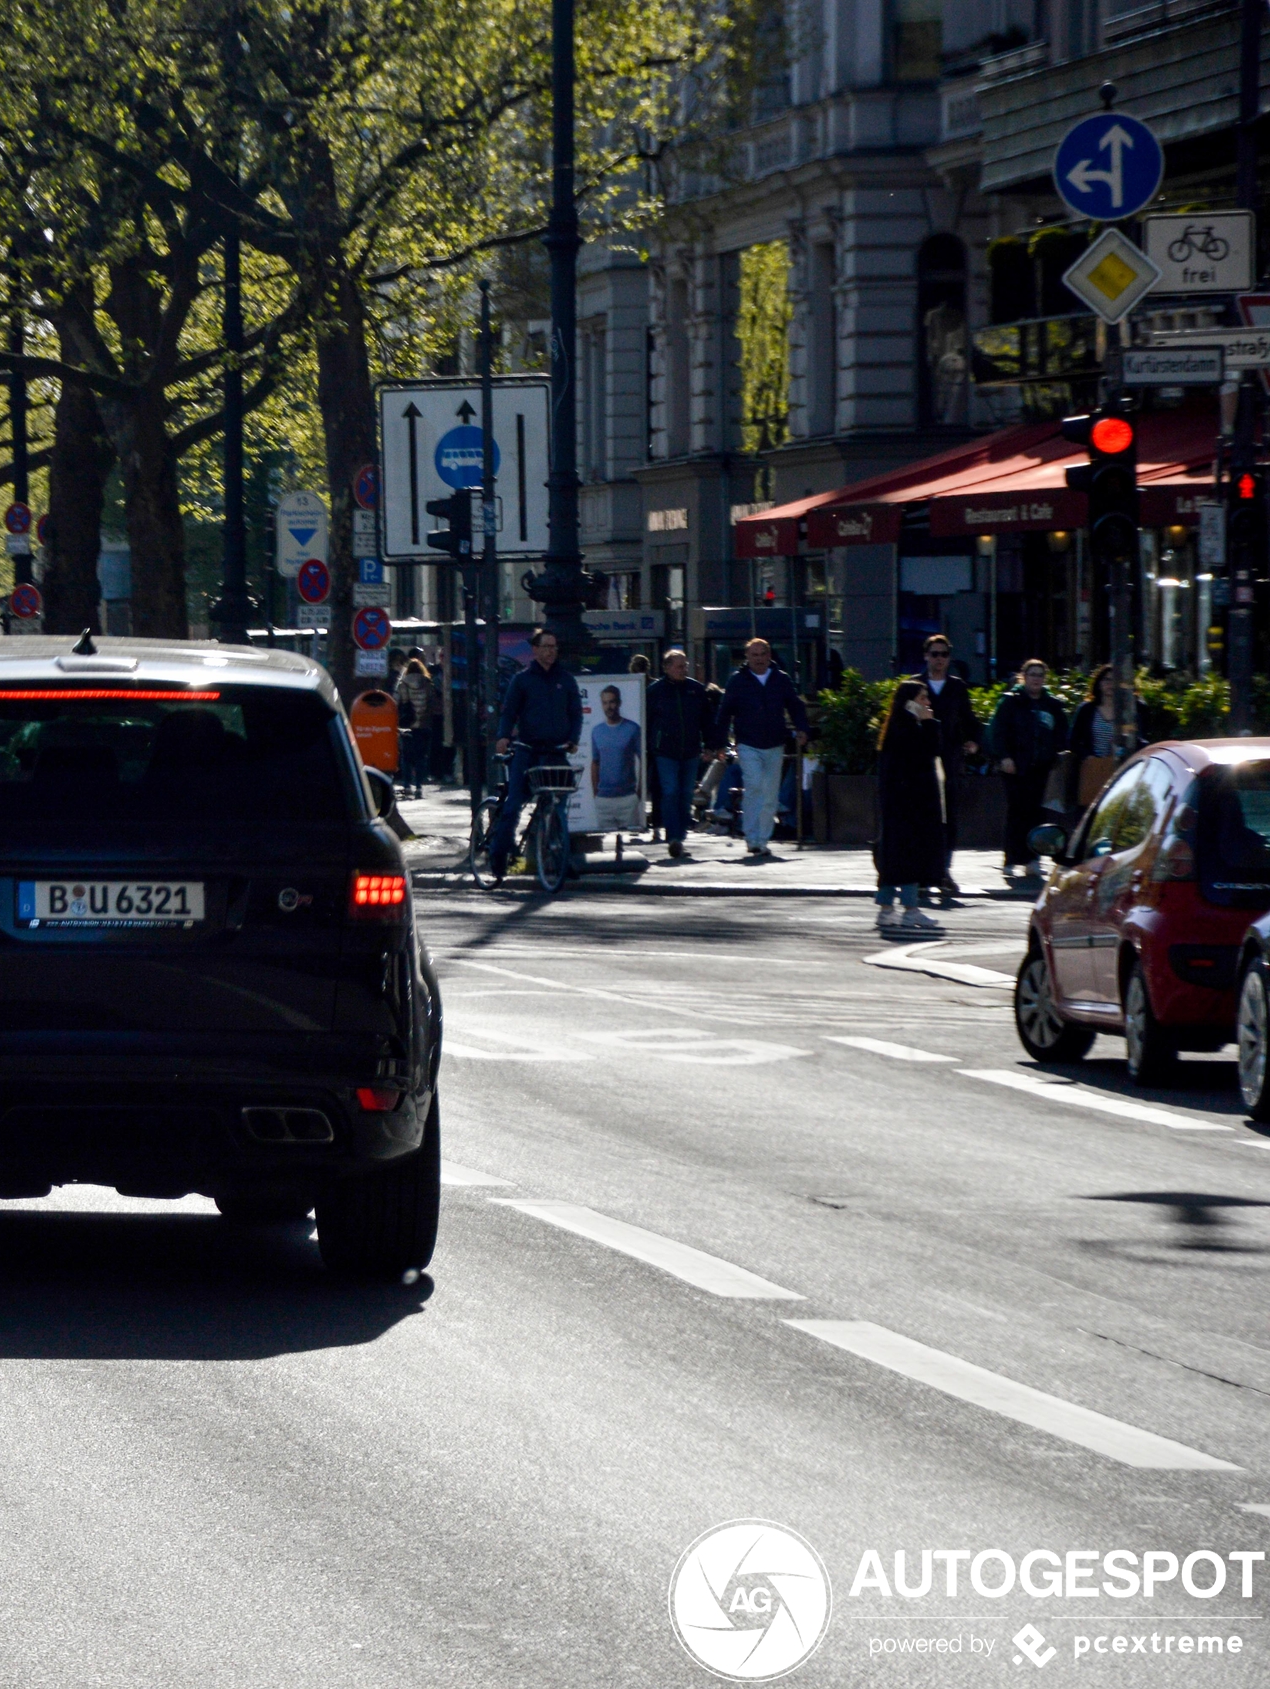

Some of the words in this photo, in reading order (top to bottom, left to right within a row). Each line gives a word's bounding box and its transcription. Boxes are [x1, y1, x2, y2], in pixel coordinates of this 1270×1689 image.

[1182, 267, 1216, 284] frei
[364, 561, 376, 581] P
[49, 885, 68, 914] B
[89, 886, 108, 914] U
[115, 885, 191, 915] 6321
